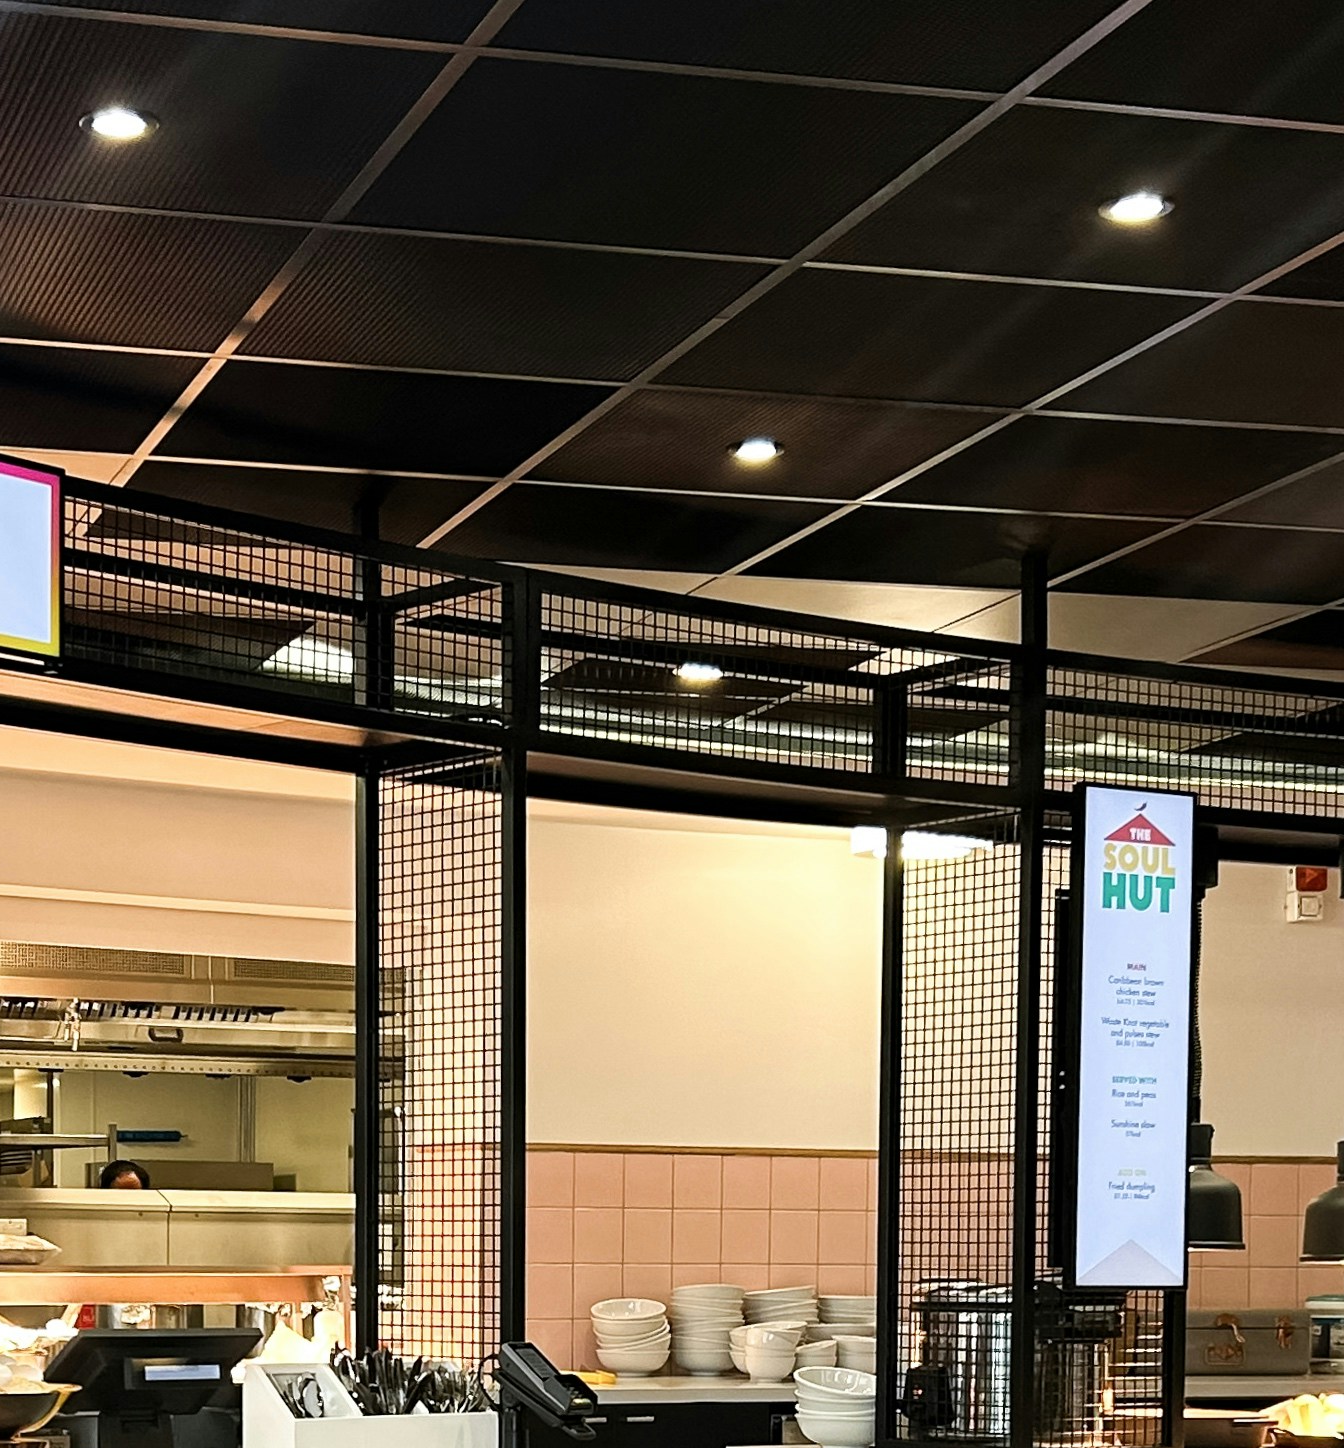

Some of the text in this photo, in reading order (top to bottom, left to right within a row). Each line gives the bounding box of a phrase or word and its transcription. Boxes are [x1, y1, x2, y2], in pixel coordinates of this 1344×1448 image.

[1129, 827, 1151, 841] THE
[1103, 842, 1176, 876] SOUL
[1102, 872, 1176, 913] HUT
